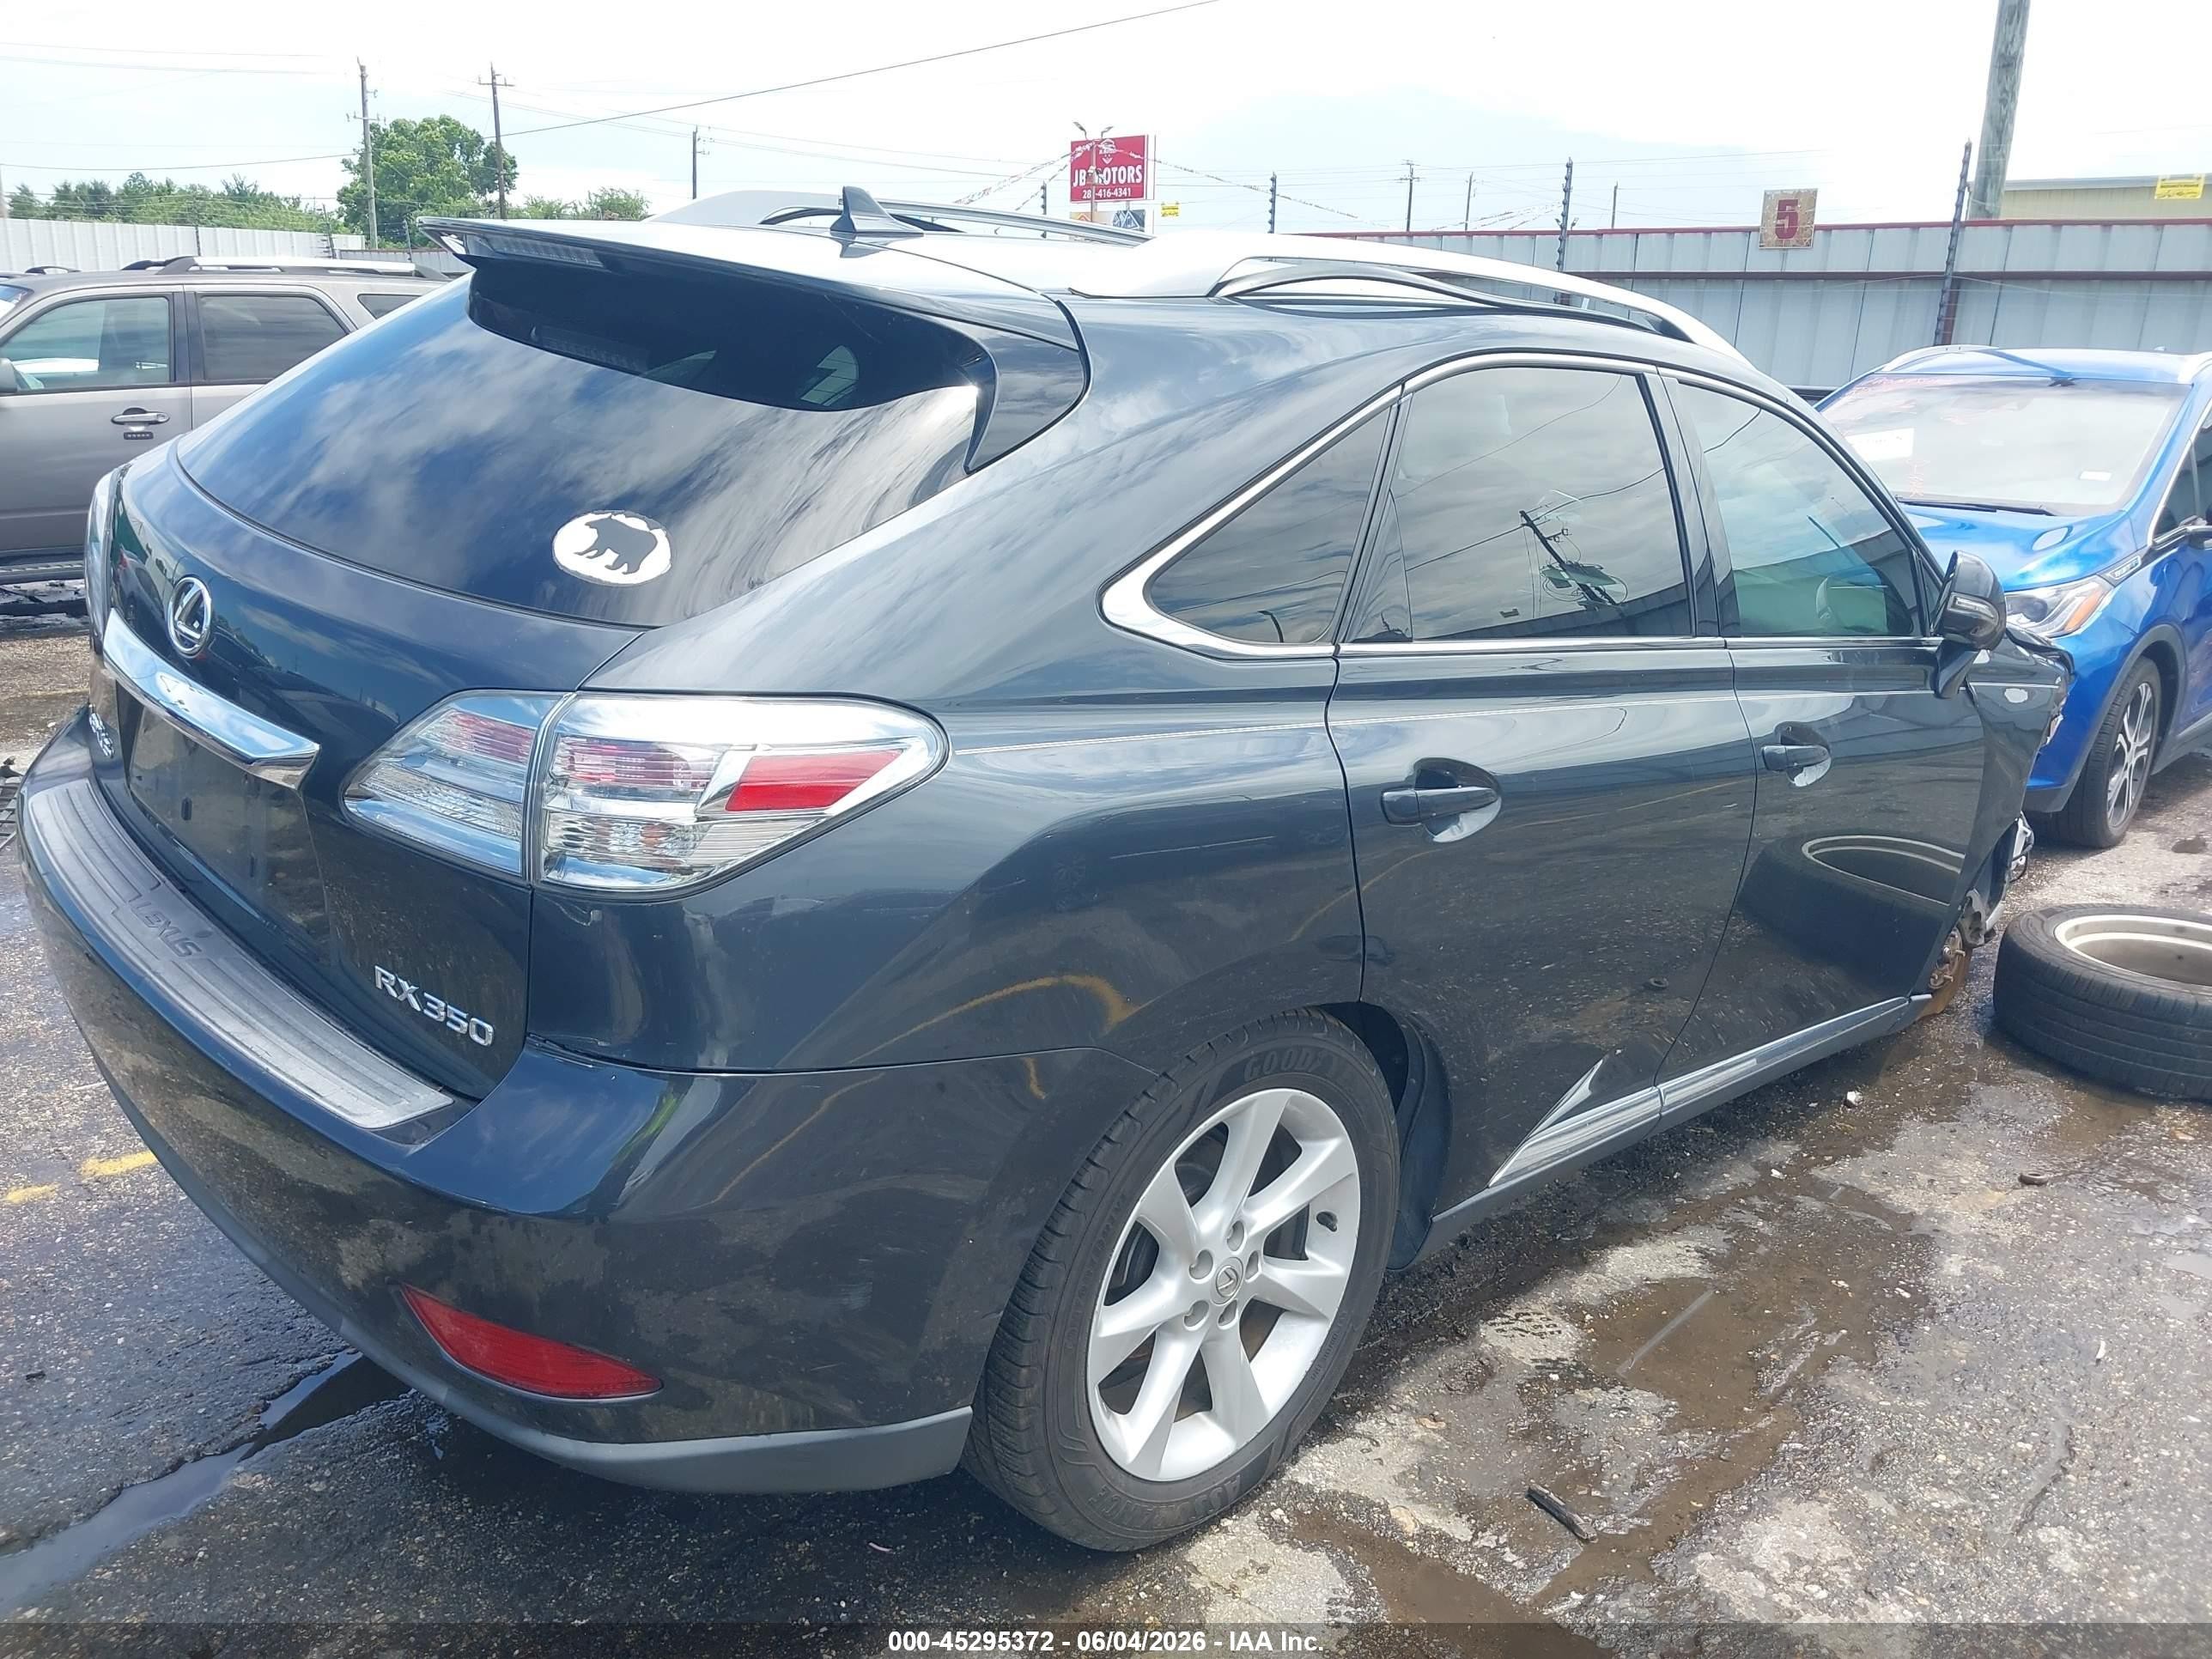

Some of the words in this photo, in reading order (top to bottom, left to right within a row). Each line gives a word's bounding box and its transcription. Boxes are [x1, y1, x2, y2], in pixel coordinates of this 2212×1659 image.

[1073, 168, 1087, 187] JB
[1082, 187, 1132, 199] 28-416-4341
[1775, 198, 1799, 240] 5
[131, 901, 202, 957] LEXUS
[374, 964, 495, 1047] RX350
